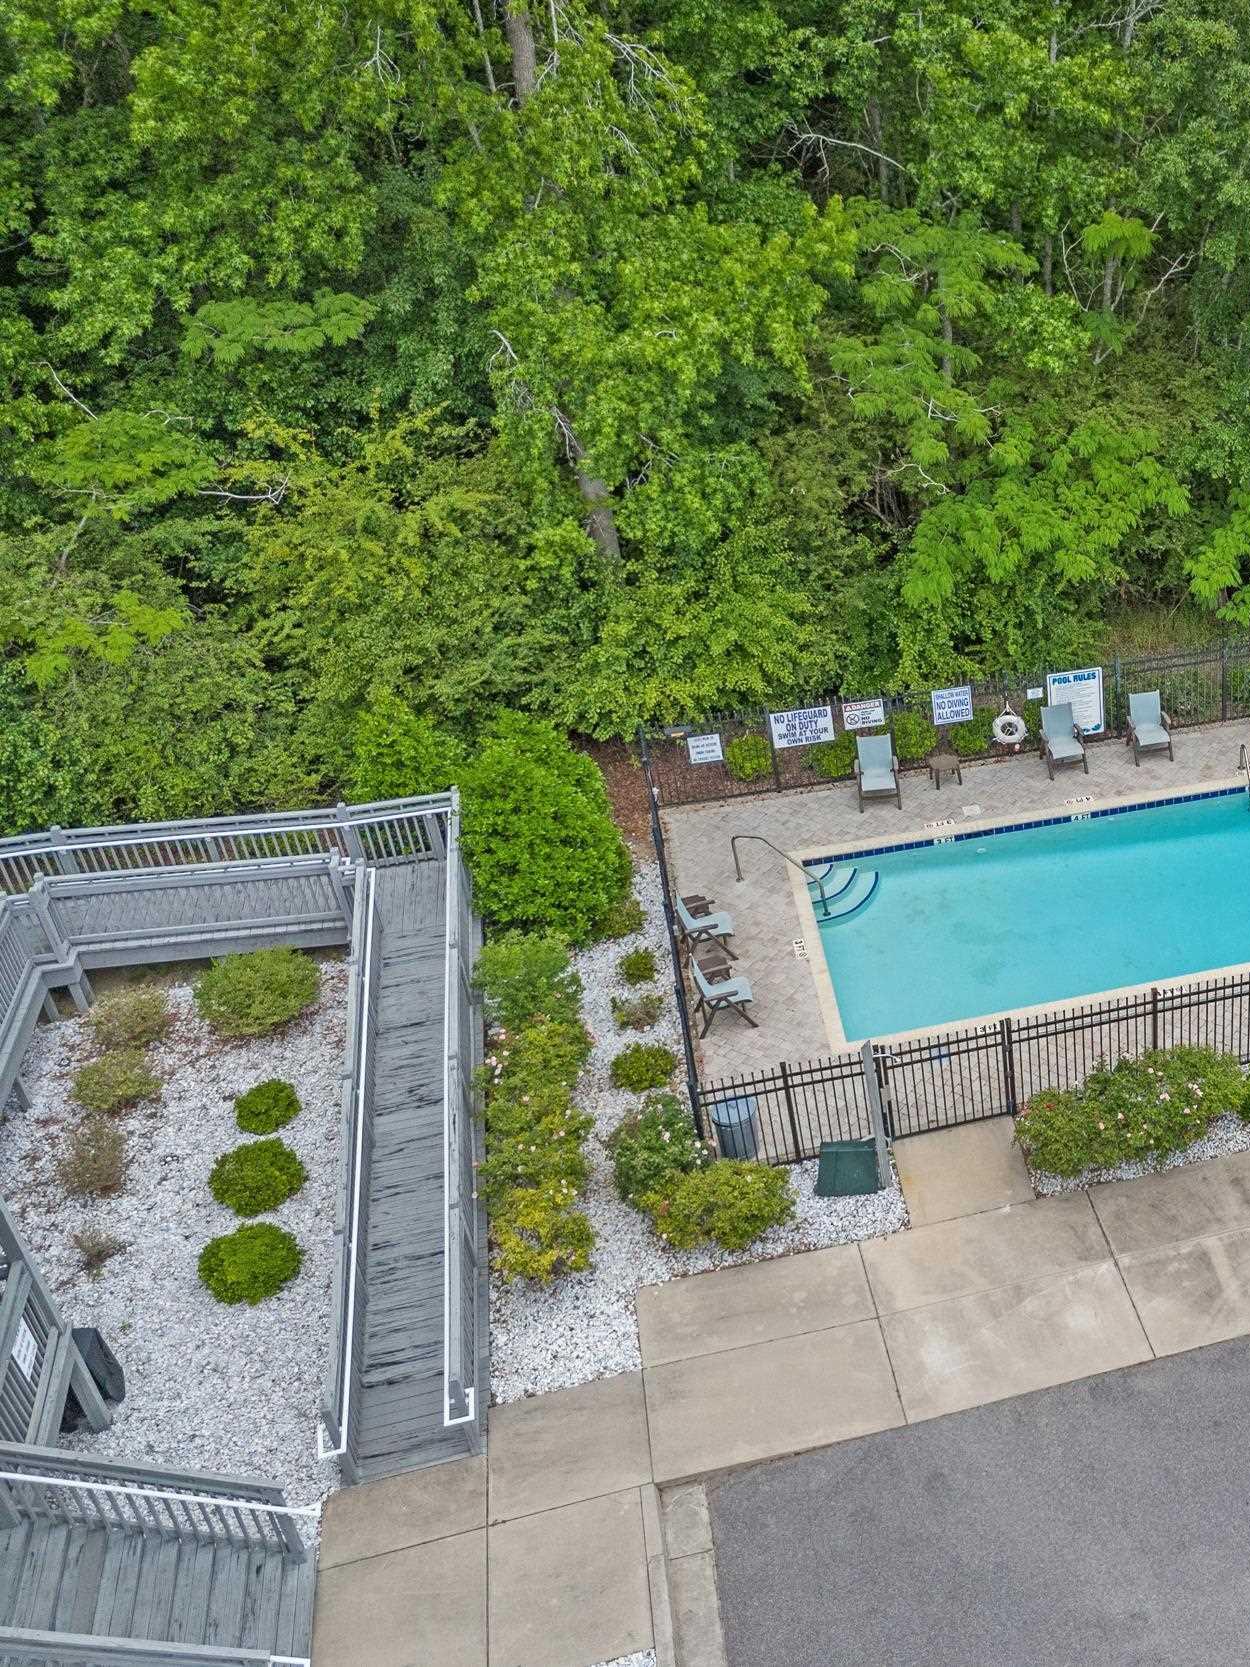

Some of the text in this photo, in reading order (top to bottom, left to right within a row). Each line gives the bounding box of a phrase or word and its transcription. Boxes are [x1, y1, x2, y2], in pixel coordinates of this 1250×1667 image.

[1052, 672, 1097, 685] POOL RULES
[936, 697, 969, 711] NO DIVING
[773, 708, 828, 724] NO LIFEGUARD
[937, 707, 970, 721] ALLOWED
[785, 719, 818, 732] ON DUTY
[777, 726, 829, 740] SWIM AT YOUR
[786, 734, 822, 745] OWN RISK
